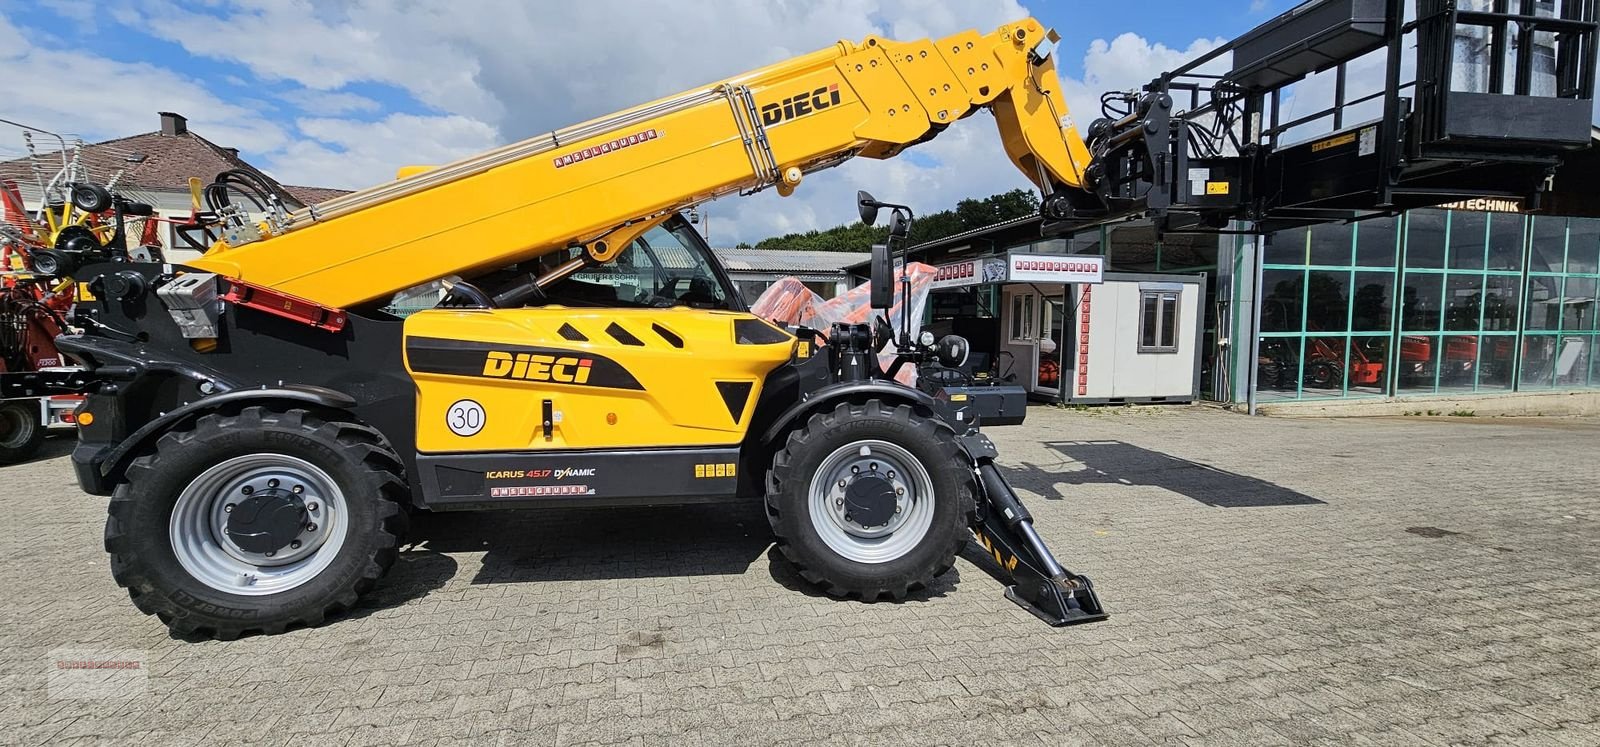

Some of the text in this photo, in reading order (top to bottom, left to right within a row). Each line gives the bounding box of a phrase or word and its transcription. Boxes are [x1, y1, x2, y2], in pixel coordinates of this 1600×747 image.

[762, 83, 840, 127] DIECI
[482, 351, 593, 384] DIECI
[452, 407, 480, 430] 30
[486, 470, 525, 479] ICARUS
[553, 467, 596, 480] DYNAMIC
